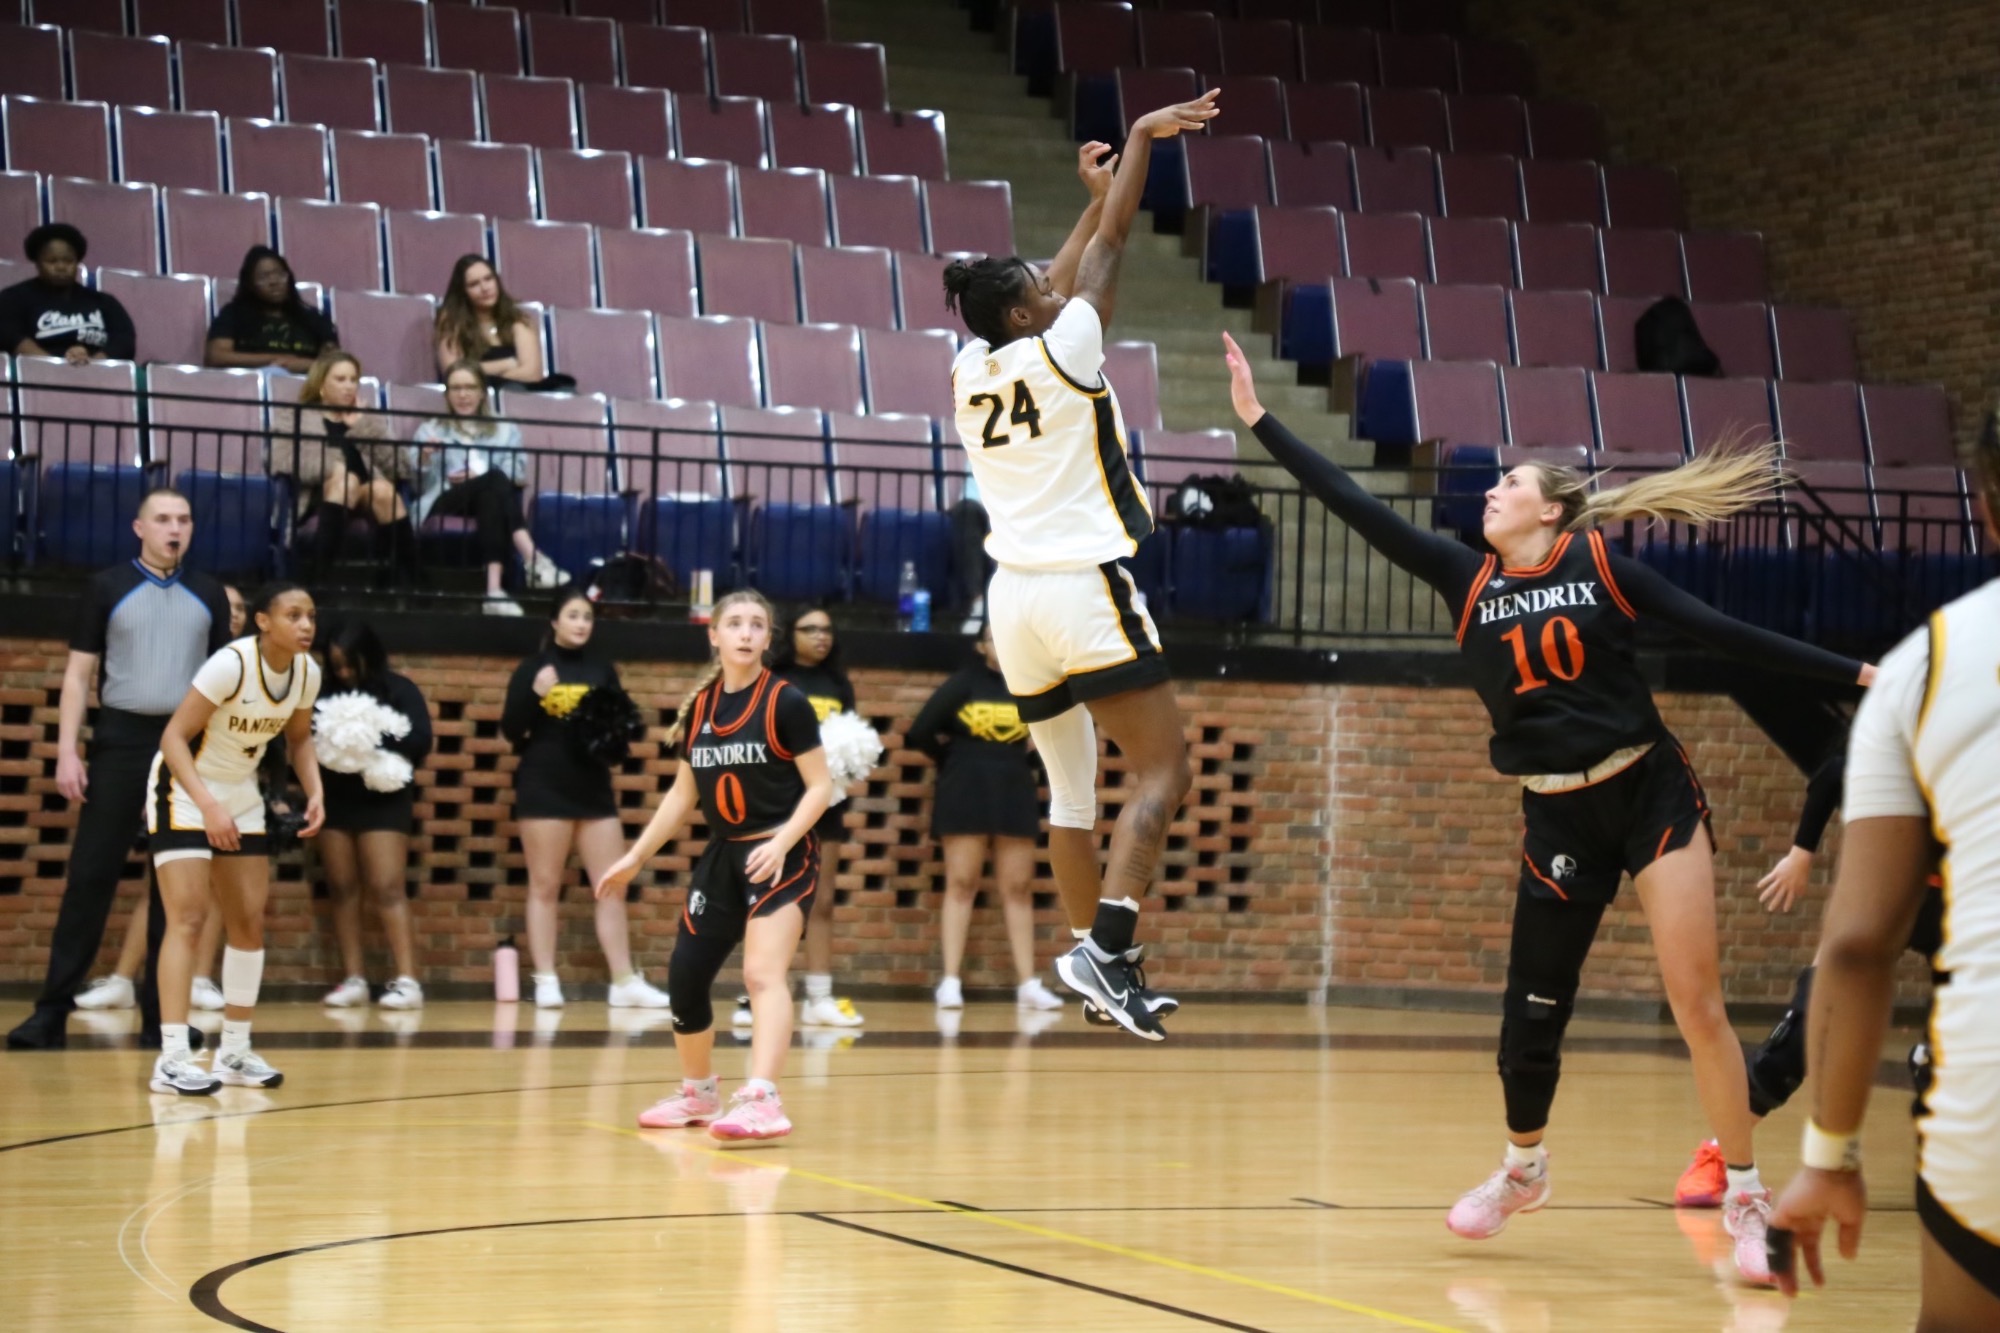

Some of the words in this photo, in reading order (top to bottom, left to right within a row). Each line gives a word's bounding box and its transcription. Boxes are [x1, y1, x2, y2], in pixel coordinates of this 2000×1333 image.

[969, 379, 1042, 449] 24
[1478, 582, 1598, 625] HENDRIX
[1500, 615, 1585, 695] 10
[691, 743, 768, 768] HENDRIX
[715, 772, 747, 825] 0
